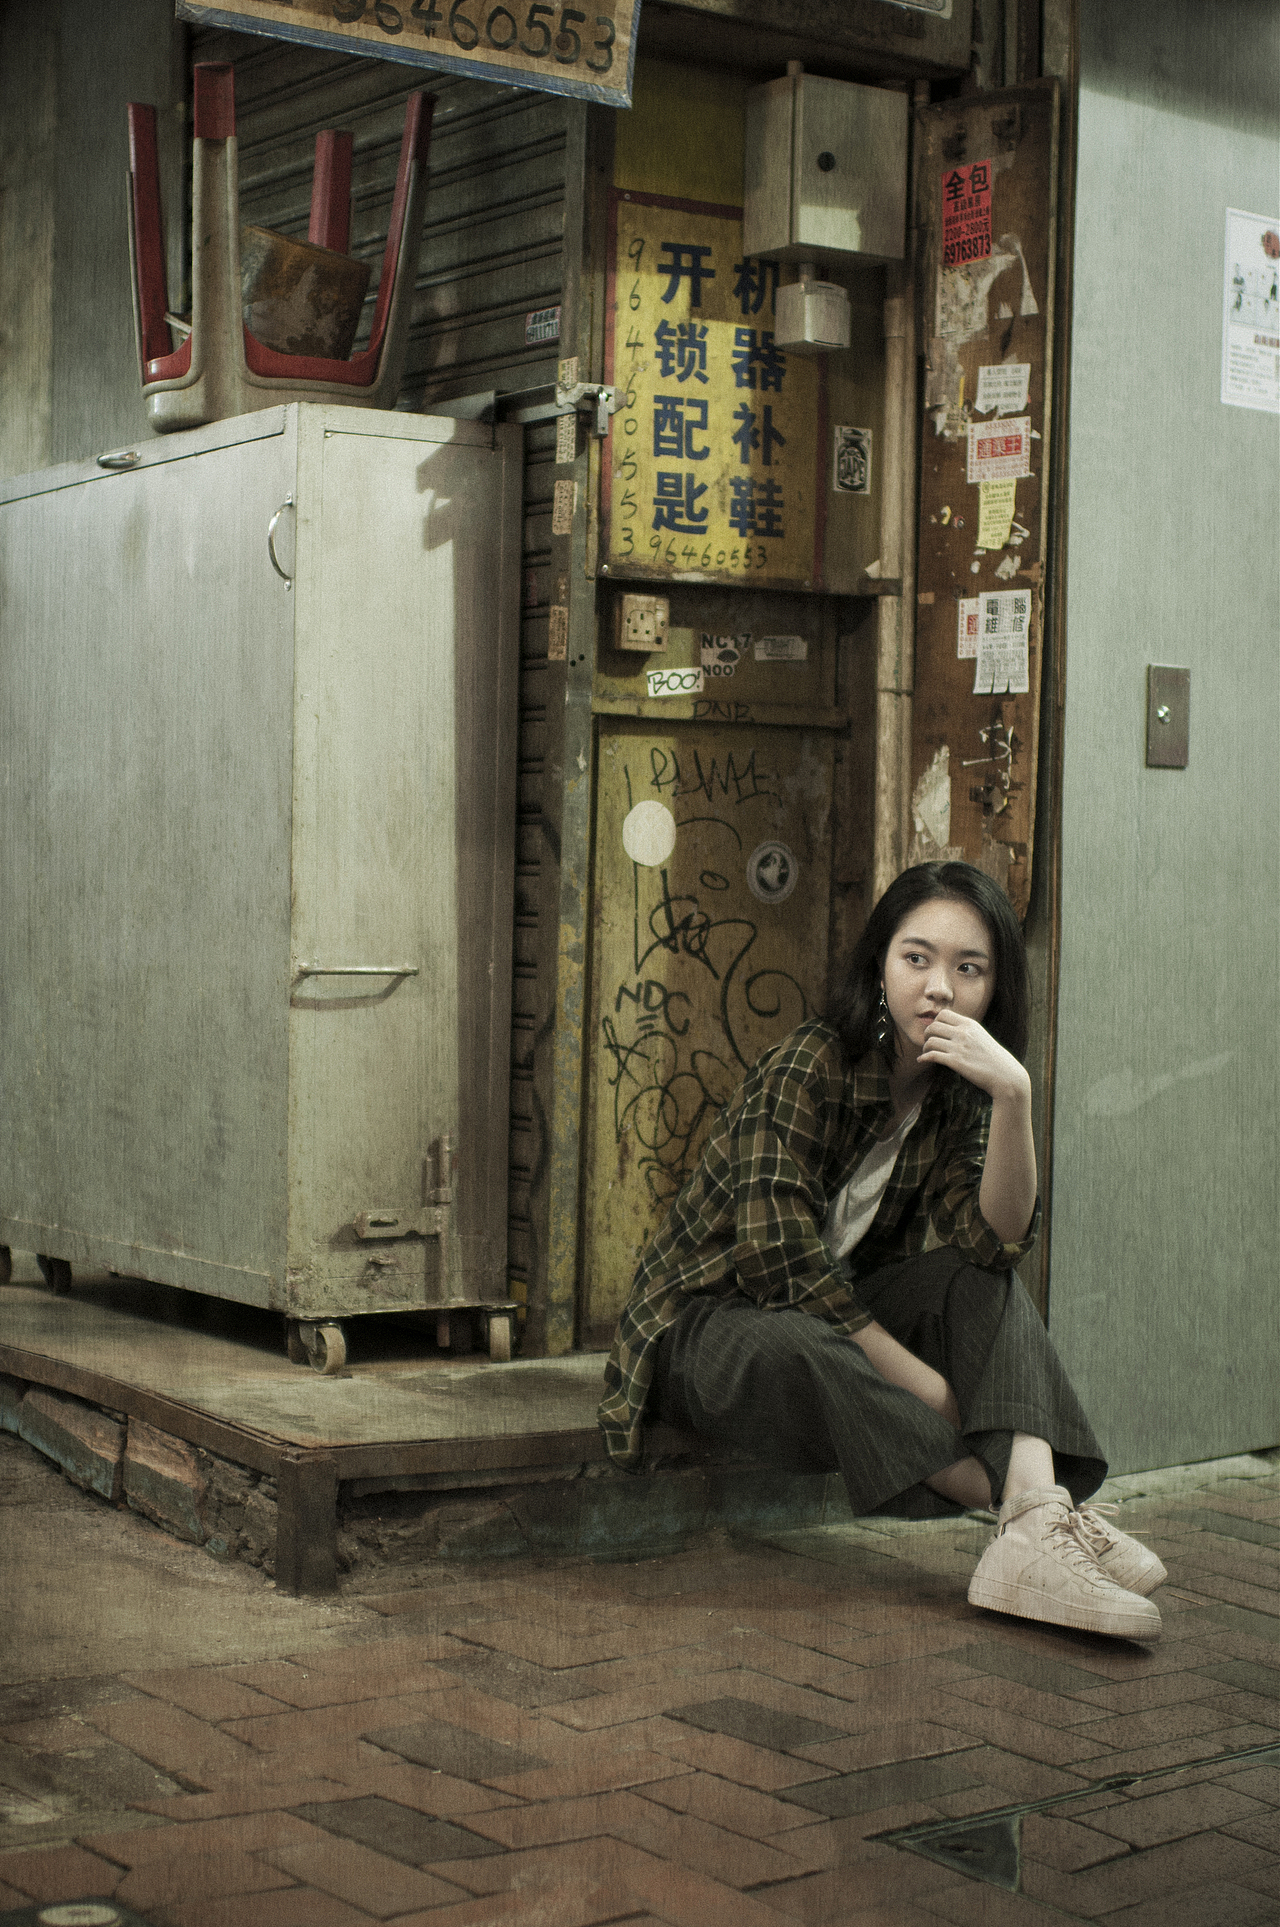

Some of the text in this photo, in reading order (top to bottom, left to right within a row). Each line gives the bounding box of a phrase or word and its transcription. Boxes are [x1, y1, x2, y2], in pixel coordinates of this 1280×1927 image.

[945, 165, 989, 200] 全包
[652, 241, 716, 535] 开锁配匙
[728, 256, 787, 538] 机器补鞋
[647, 671, 701, 694] BOO!
